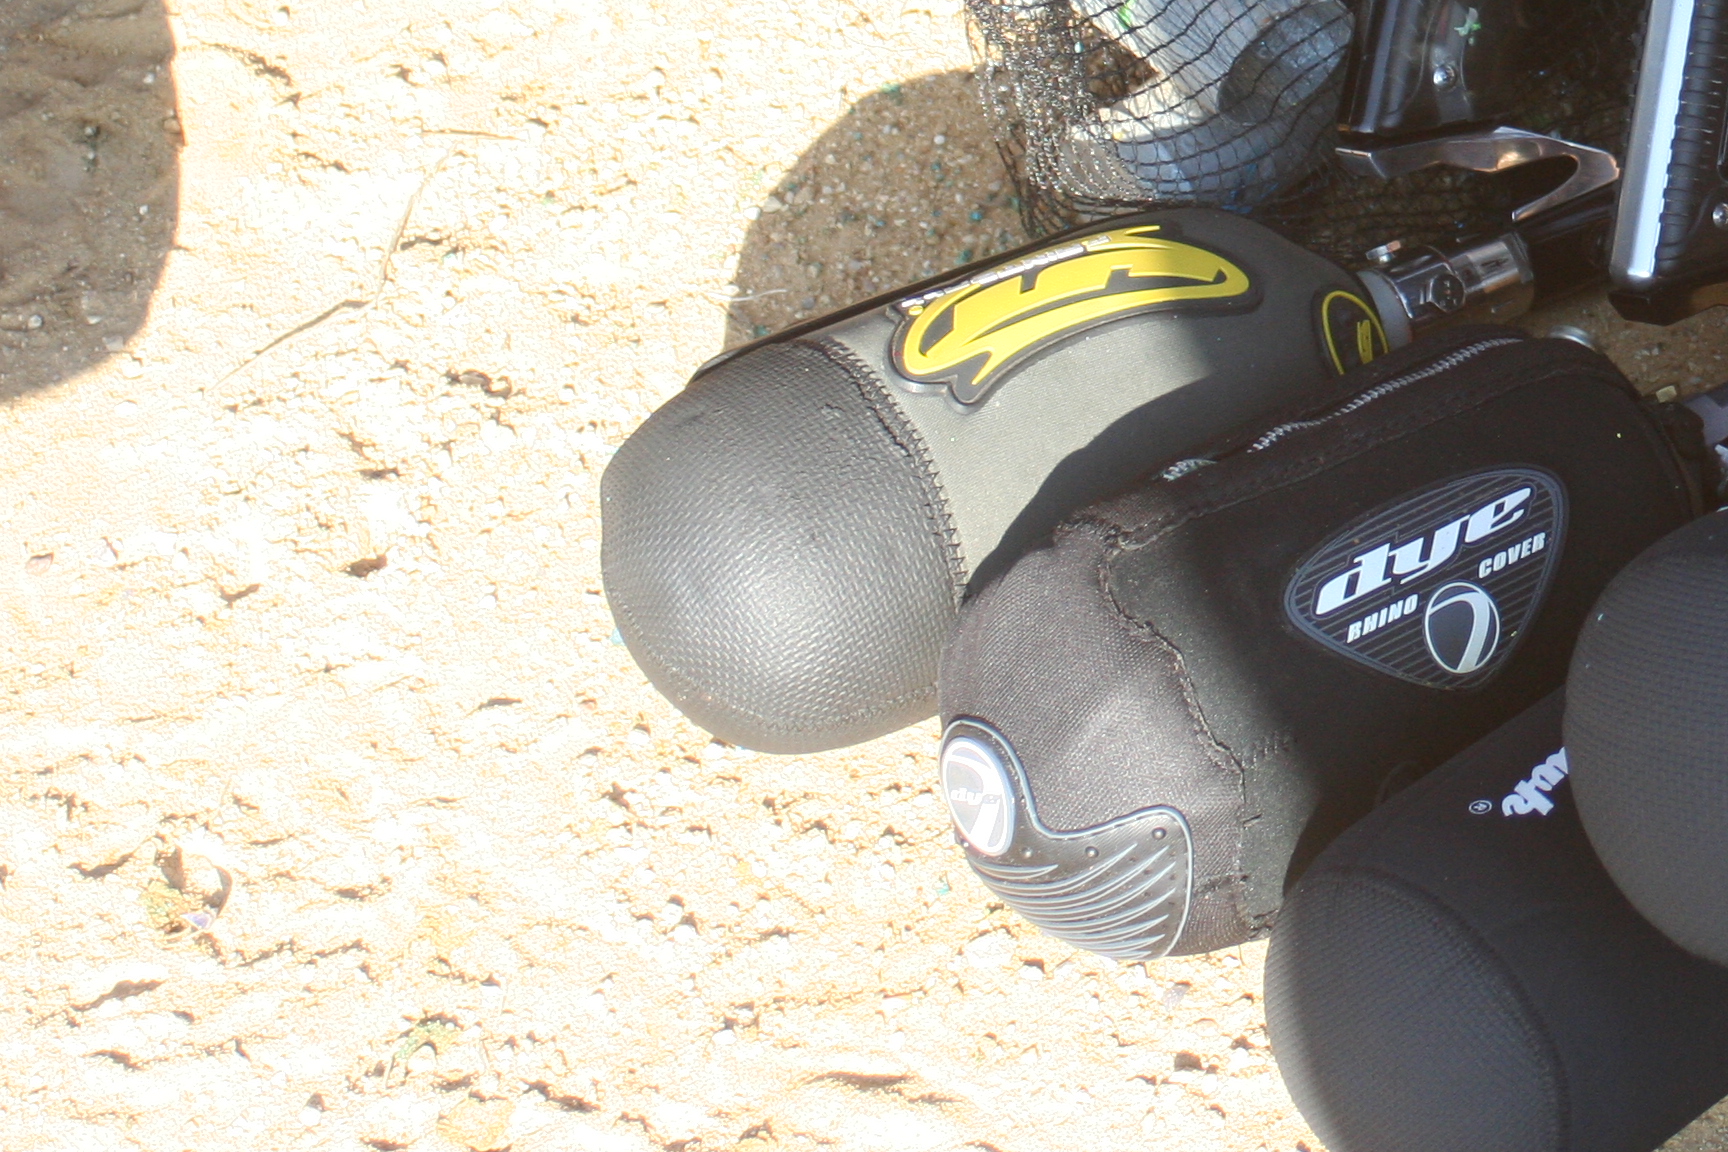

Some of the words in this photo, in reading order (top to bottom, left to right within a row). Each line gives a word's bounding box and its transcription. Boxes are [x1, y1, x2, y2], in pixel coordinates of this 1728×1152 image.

[1316, 487, 1531, 615] dye
[1347, 593, 1418, 644] RHINO
[1478, 532, 1546, 579] COVER
[950, 787, 1002, 806] dye
